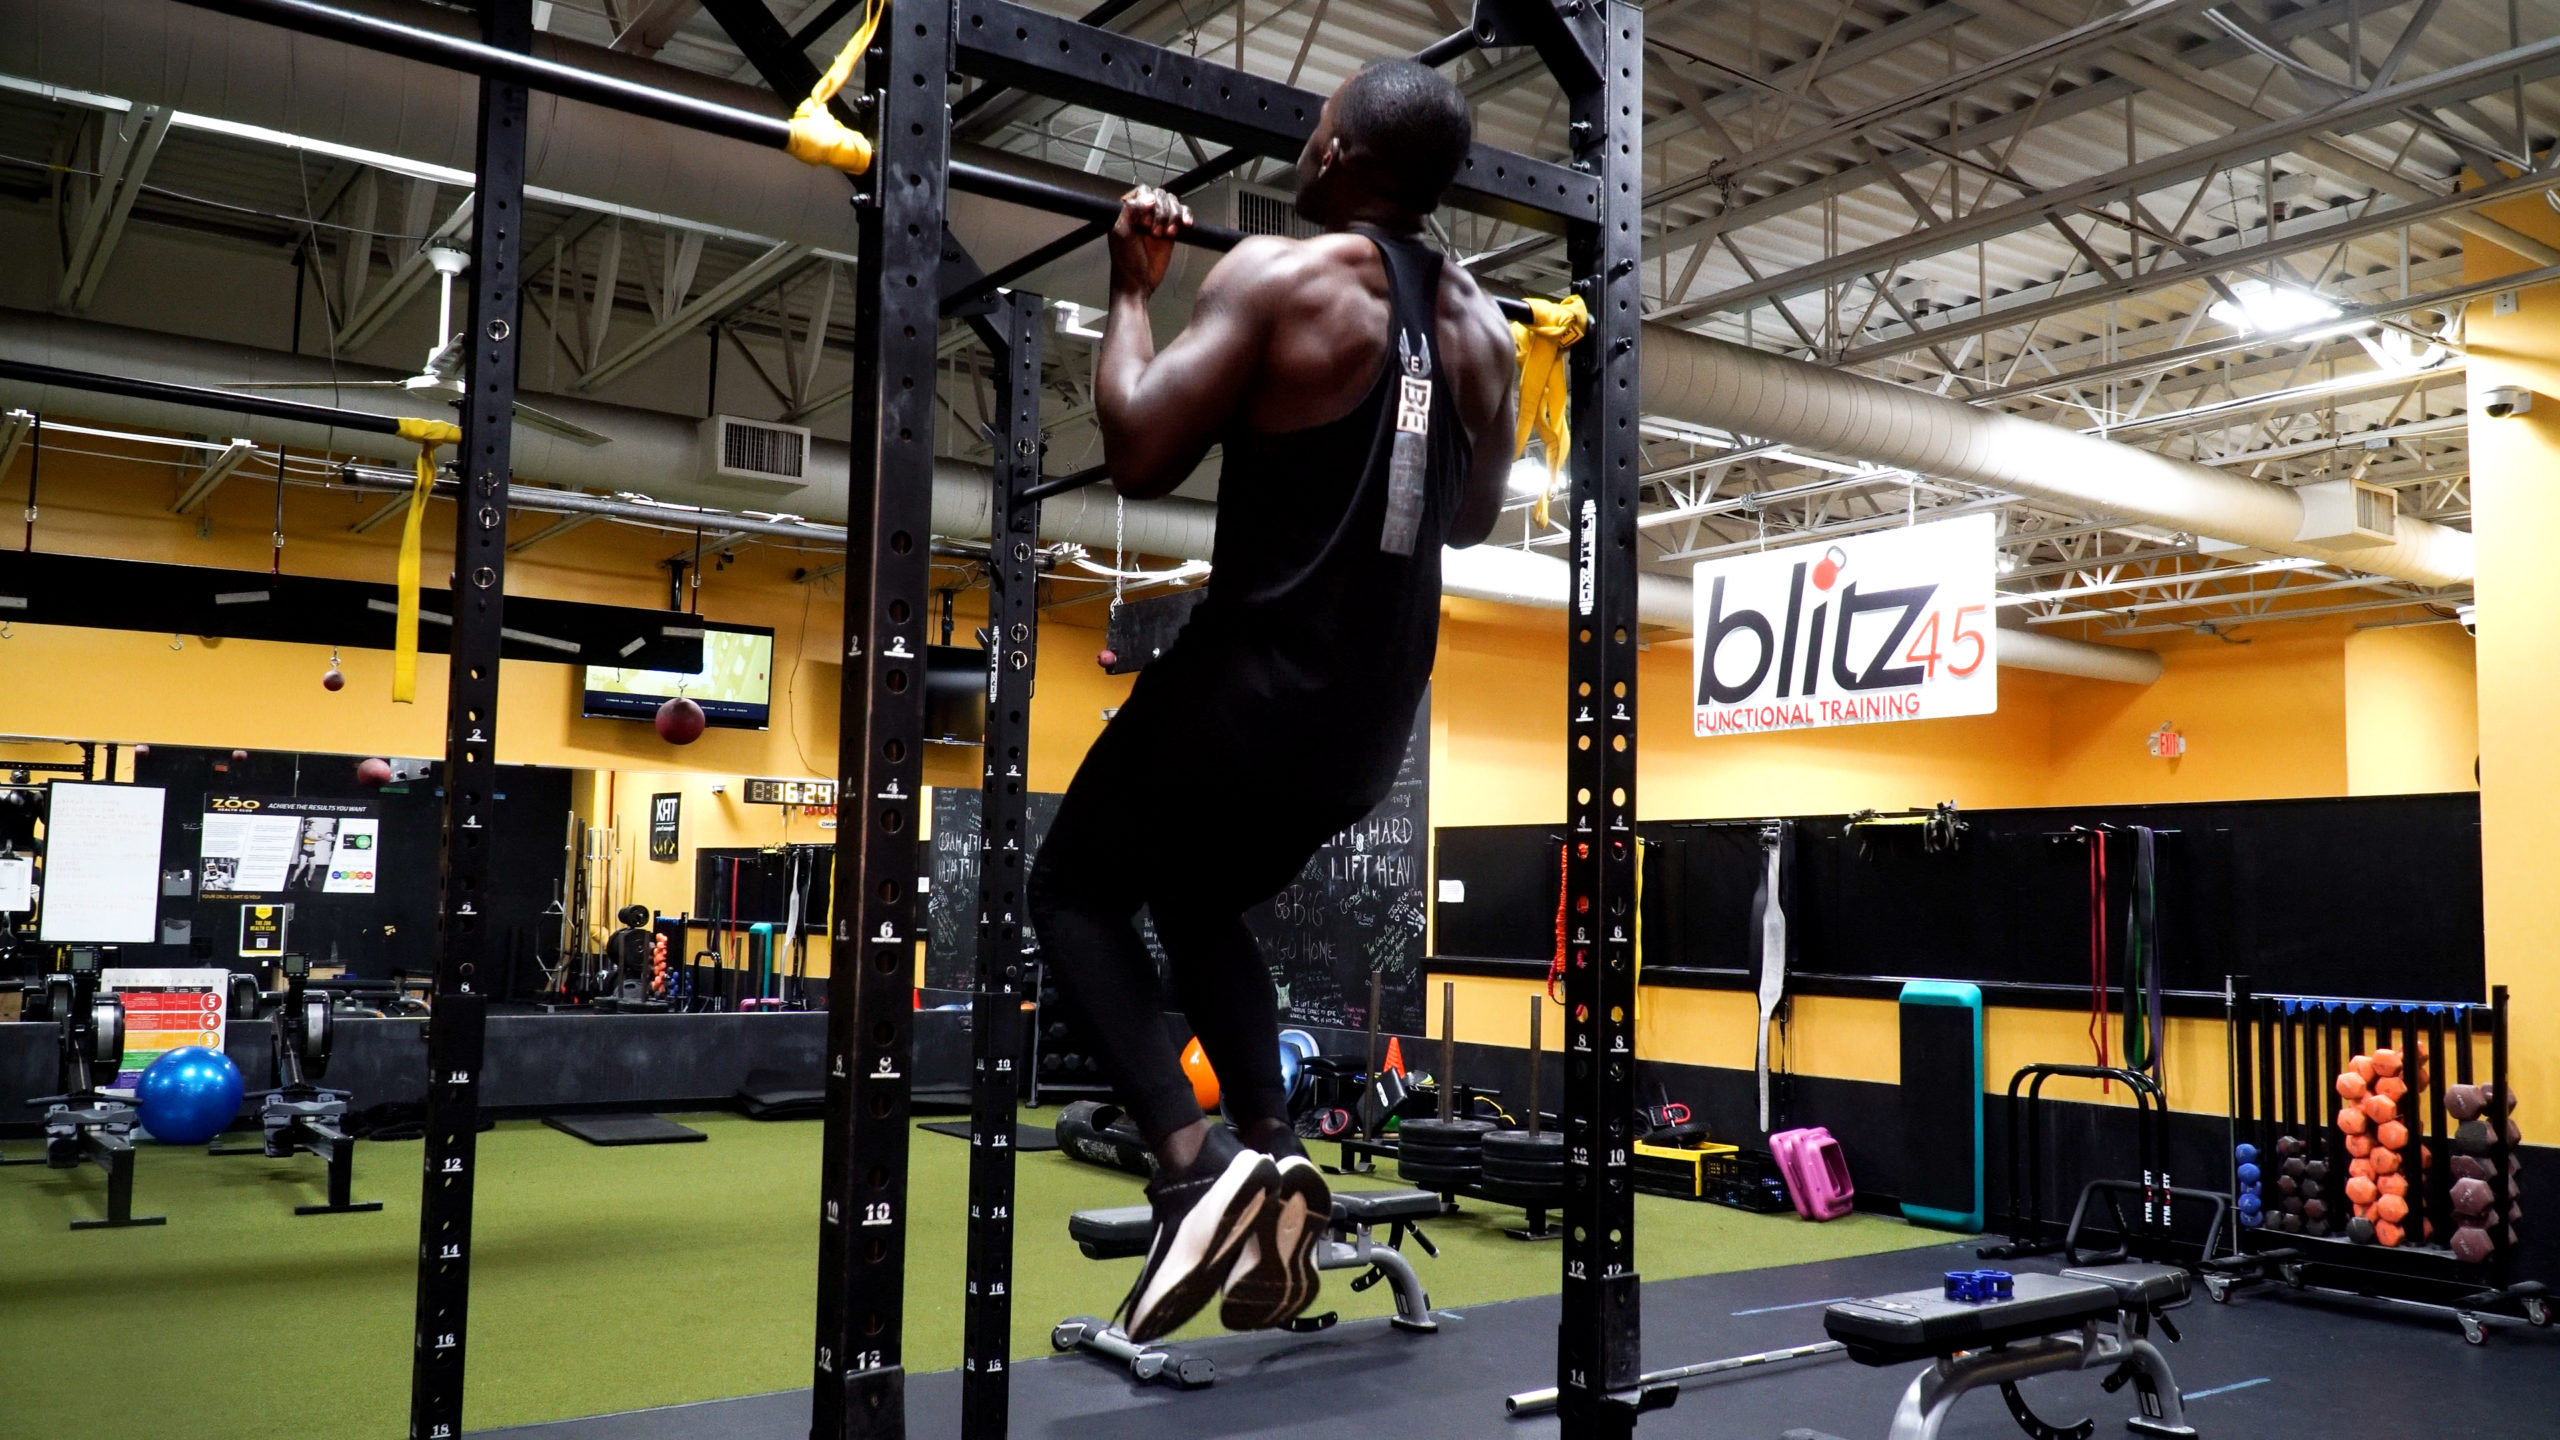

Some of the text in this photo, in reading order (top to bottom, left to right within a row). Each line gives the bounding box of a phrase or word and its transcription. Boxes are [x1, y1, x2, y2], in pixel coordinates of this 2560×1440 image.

[1411, 355, 1420, 372] E
[1697, 546, 1986, 705] blitz 45
[892, 636, 906, 653] 2
[1617, 704, 1625, 717] 2
[1697, 692, 1920, 731] FUNCTIONAL TRAINING
[472, 729, 481, 739] 2
[2160, 733, 2177, 756] EXIT
[1010, 764, 1017, 774] 2
[886, 778, 899, 795] 4
[212, 798, 260, 809] ZOO
[467, 815, 476, 826] 4
[1615, 815, 1623, 827] 4
[1369, 817, 1413, 846] HARD
[1007, 839, 1014, 848] 4
[1004, 912, 1011, 922] 6
[880, 921, 894, 938] 6
[1614, 926, 1622, 938] 6
[461, 982, 470, 993] 8
[1004, 984, 1011, 993] 8
[207, 999, 216, 1007] 5
[206, 1017, 215, 1026] 4
[1615, 1036, 1623, 1049] 8
[879, 1056, 892, 1073] 8
[997, 1059, 1010, 1068] 10
[993, 1135, 1006, 1144] 12
[1610, 1148, 1625, 1162] 10
[444, 1158, 462, 1169] 12
[865, 1202, 890, 1220] 10
[993, 1206, 1006, 1216] 14
[442, 1244, 459, 1256] 14
[1570, 1261, 1584, 1275] 12
[991, 1283, 1004, 1292] 16
[437, 1334, 454, 1345] 16
[857, 1350, 881, 1369] 12
[1571, 1369, 1584, 1383] 14
[432, 1425, 449, 1435] 18
